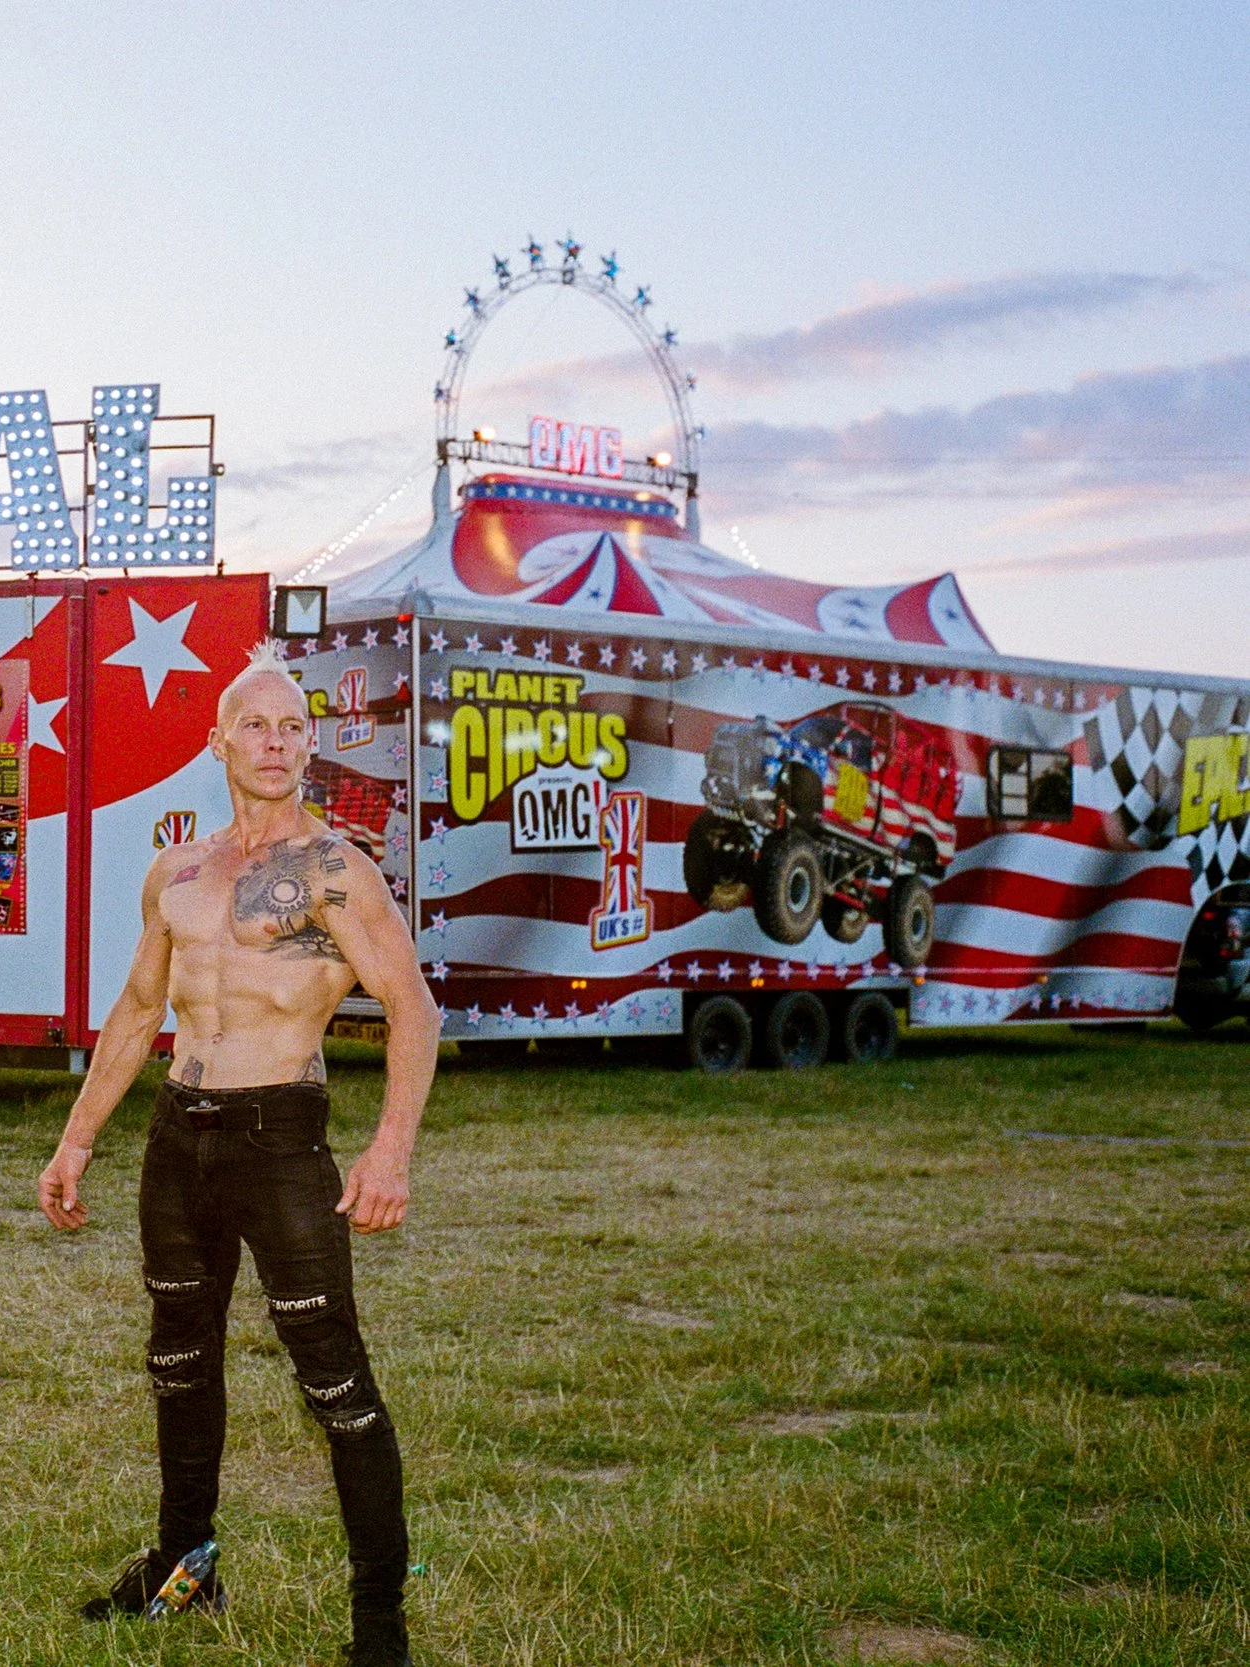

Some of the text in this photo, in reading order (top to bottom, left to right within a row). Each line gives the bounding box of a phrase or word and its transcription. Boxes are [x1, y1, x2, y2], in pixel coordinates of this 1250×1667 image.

[528, 415, 623, 480] OMG
[450, 668, 584, 705] PLANET
[449, 704, 630, 822] CIRCUS
[599, 916, 630, 942] UK's
